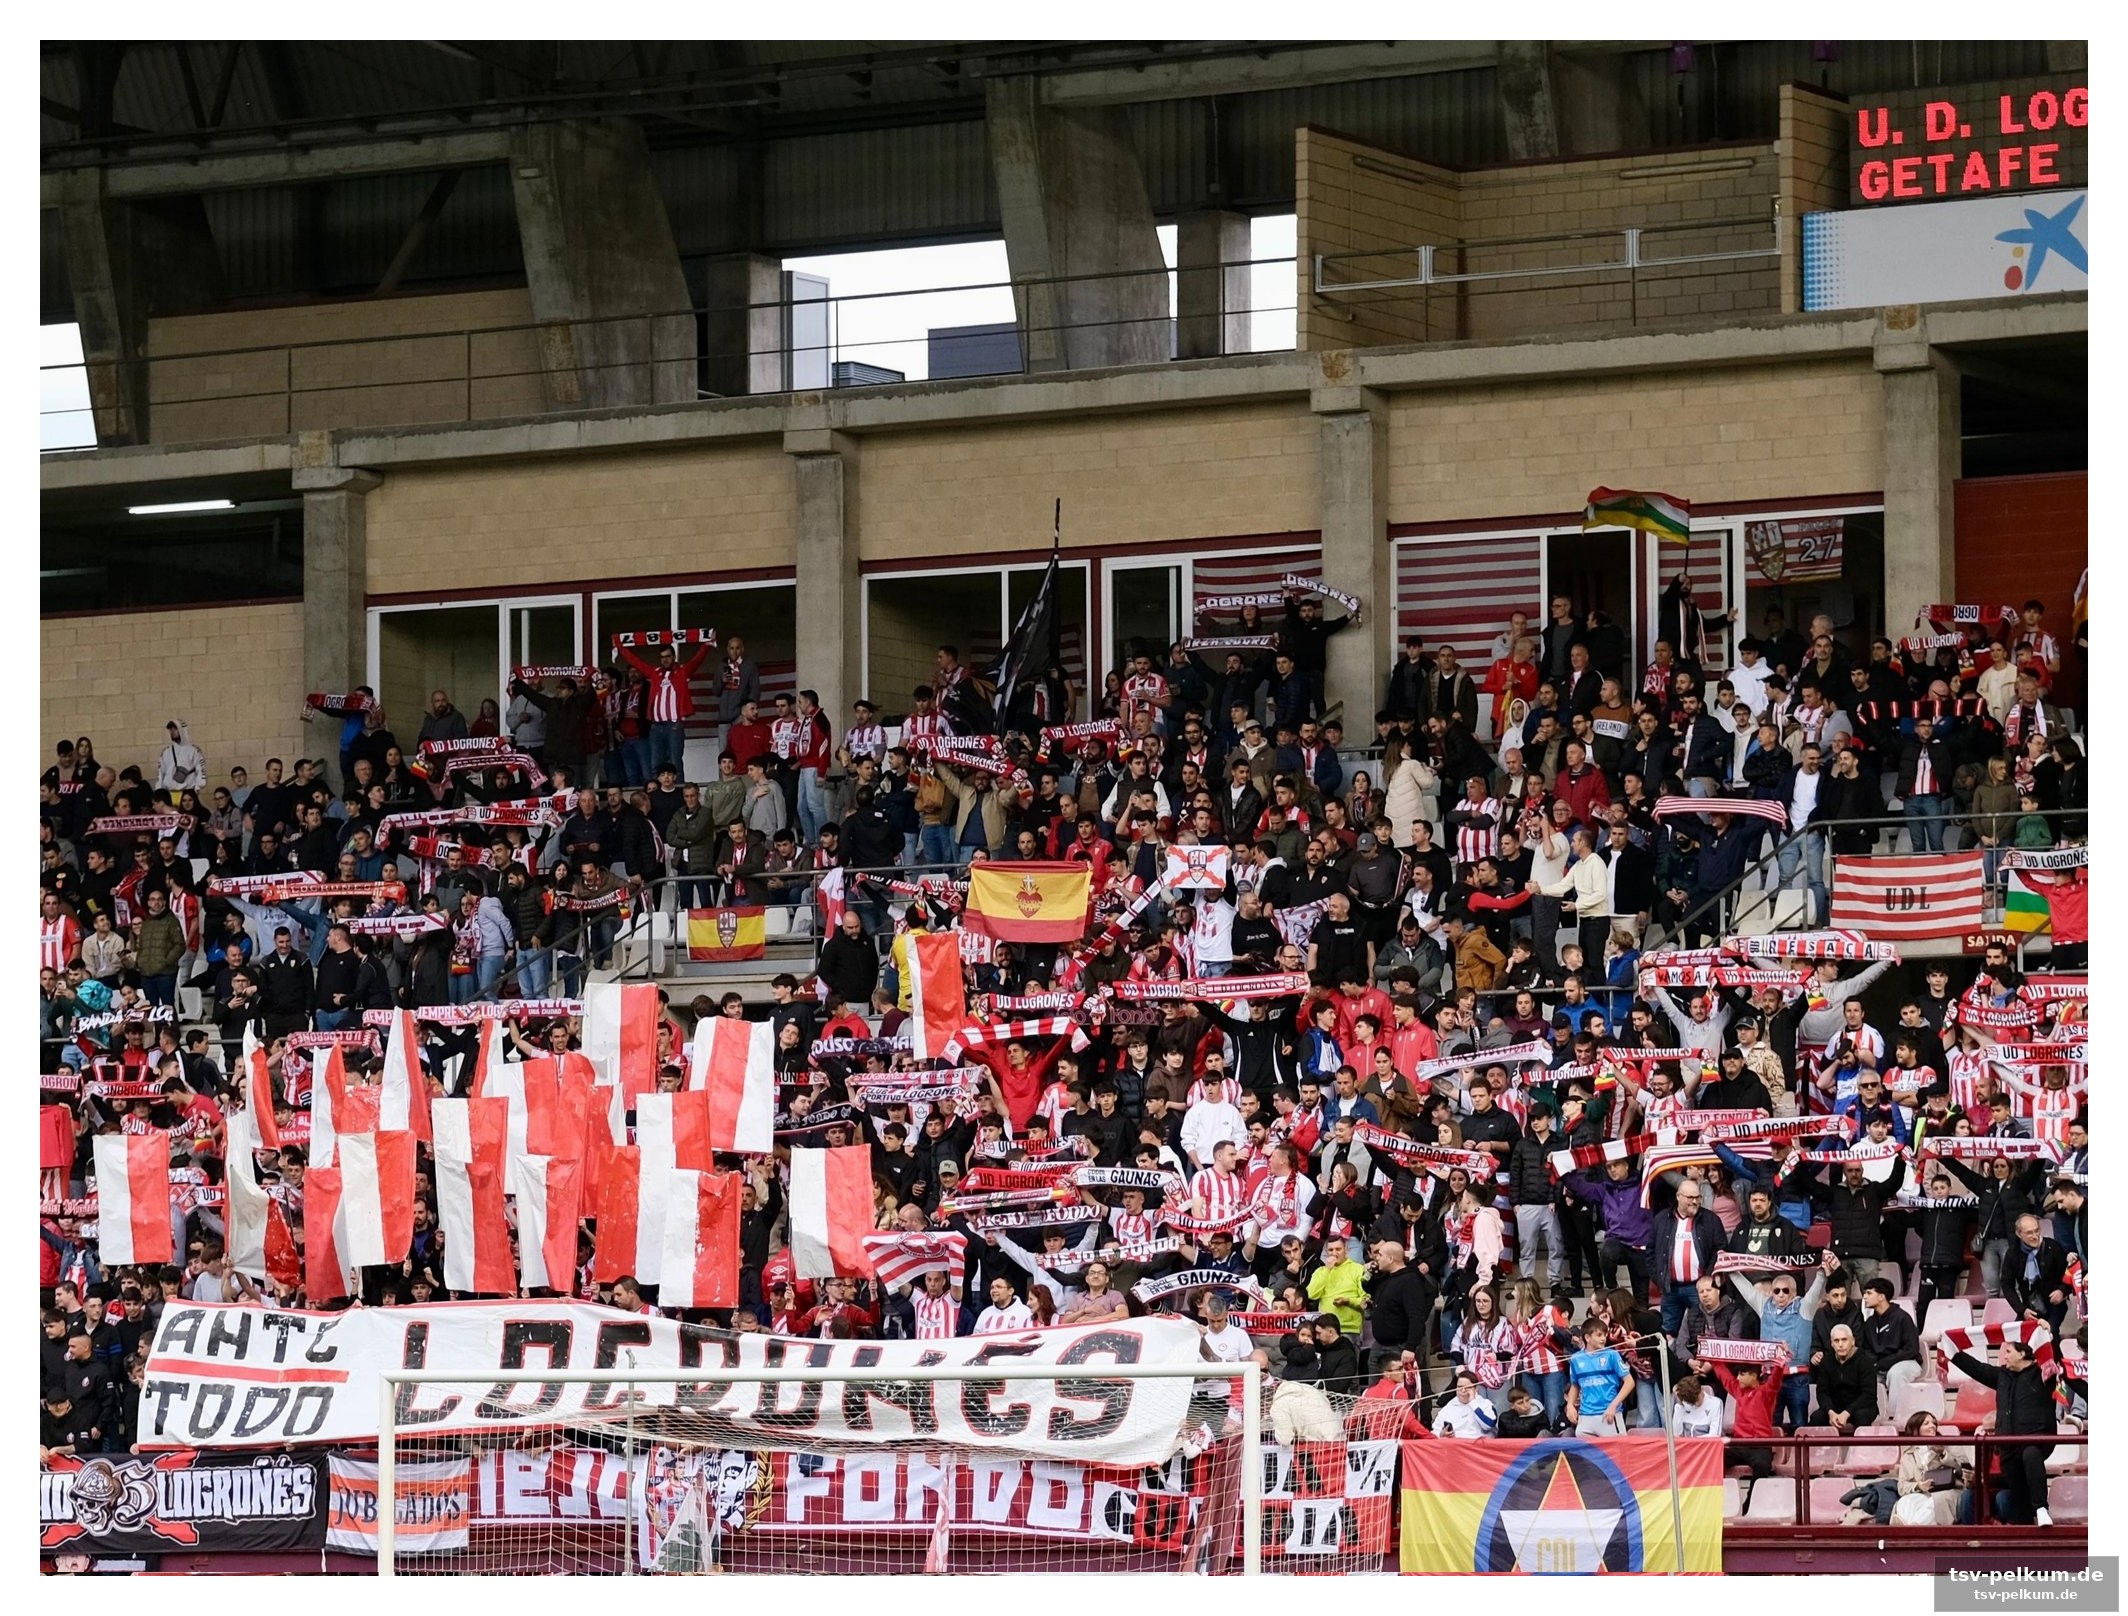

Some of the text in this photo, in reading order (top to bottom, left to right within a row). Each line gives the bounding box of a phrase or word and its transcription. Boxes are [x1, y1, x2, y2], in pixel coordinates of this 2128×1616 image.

[1858, 88, 2088, 147] U. D. LOG
[1859, 143, 2060, 200] GETAFE
[1799, 535, 1838, 563] 27
[431, 740, 445, 753] UD
[479, 807, 492, 819] UD
[2024, 855, 2039, 868] UD
[1885, 887, 1930, 911] UDL
[1724, 970, 1740, 983] UD
[1123, 984, 1139, 996] UD
[2026, 985, 2045, 1000] UD
[997, 994, 1011, 1009] UD
[2003, 1046, 2018, 1060] UD
[1733, 1125, 1750, 1138] UD
[1383, 1136, 1399, 1151] UD
[979, 1173, 994, 1188] UD
[1110, 1170, 1161, 1187] GAUNAS
[202, 1188, 217, 1201] UD
[1177, 1271, 1241, 1287] GAUNAS
[1710, 1343, 1721, 1357] UD
[146, 1380, 334, 1440] TODO
[338, 1486, 461, 1525] JUBLADOS
